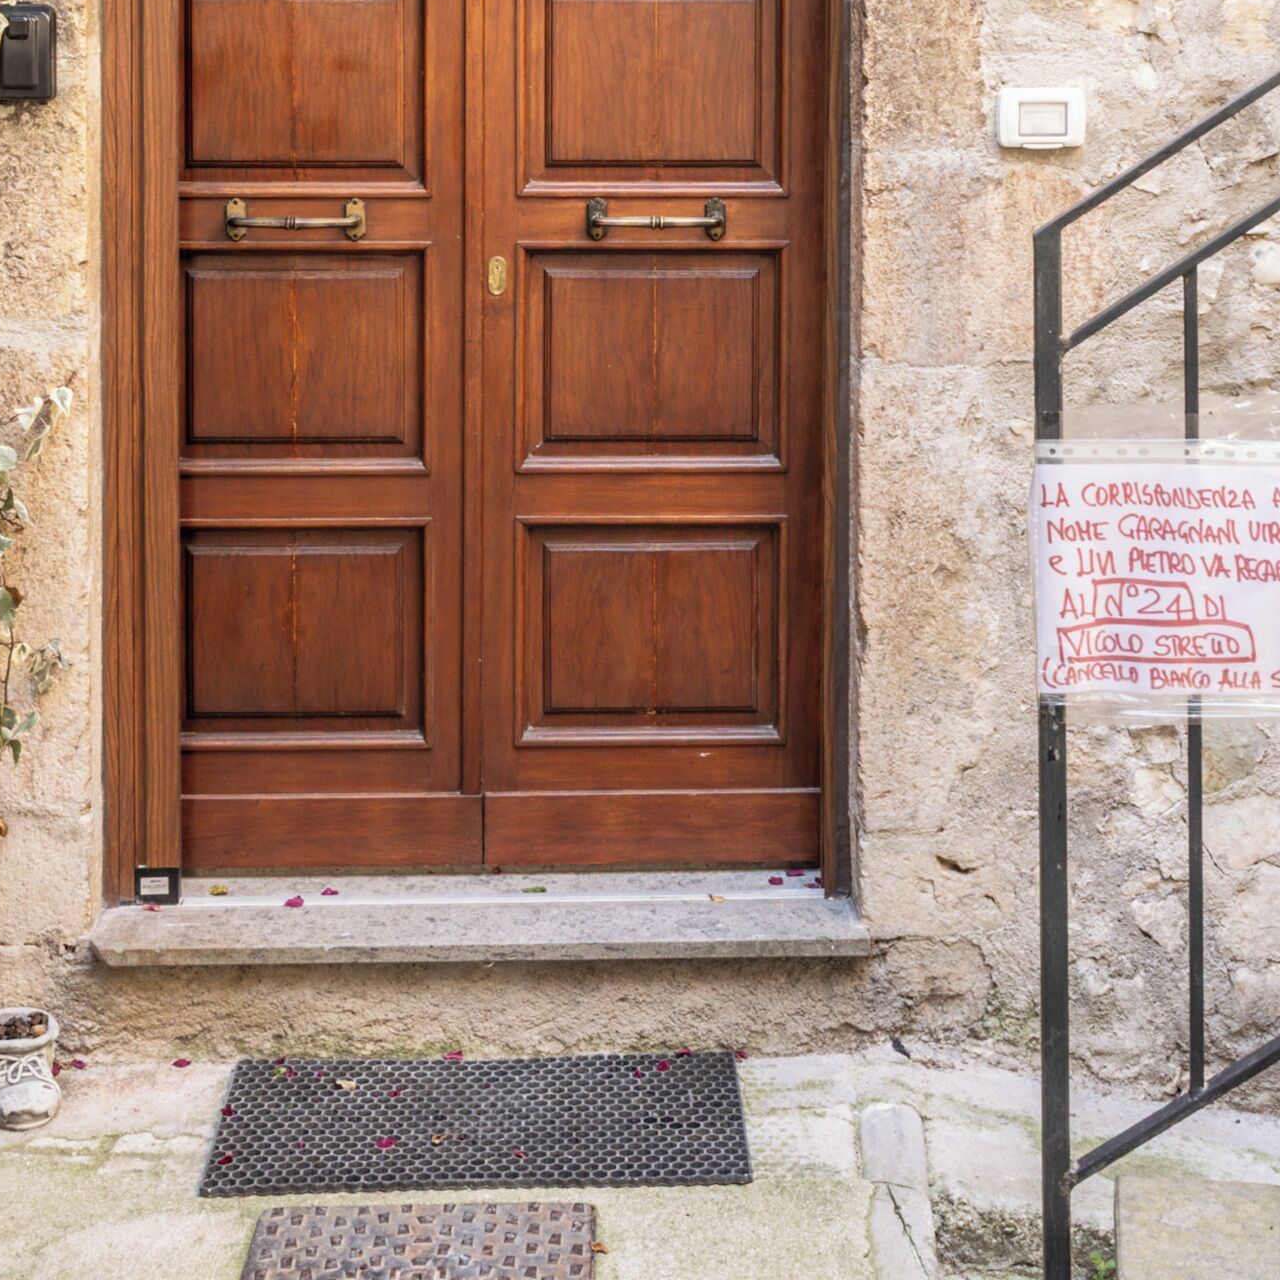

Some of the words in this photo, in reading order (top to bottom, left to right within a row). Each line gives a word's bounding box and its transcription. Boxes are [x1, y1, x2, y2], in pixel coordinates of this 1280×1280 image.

[1040, 482, 1070, 508] LA
[1081, 482, 1256, 510] CORRISPONDENZA
[1047, 517, 1109, 544] NOME
[1118, 513, 1240, 545] GARAGNANI
[1128, 546, 1196, 576] PIETRO
[1200, 552, 1231, 578] VA
[1059, 588, 1095, 619] AL
[1203, 593, 1227, 620] DI
[1062, 630, 1143, 656] VICOLO
[1153, 632, 1240, 657] STRETTO
[1150, 667, 1211, 689] BIANCO
[1218, 668, 1261, 691] ALLA
